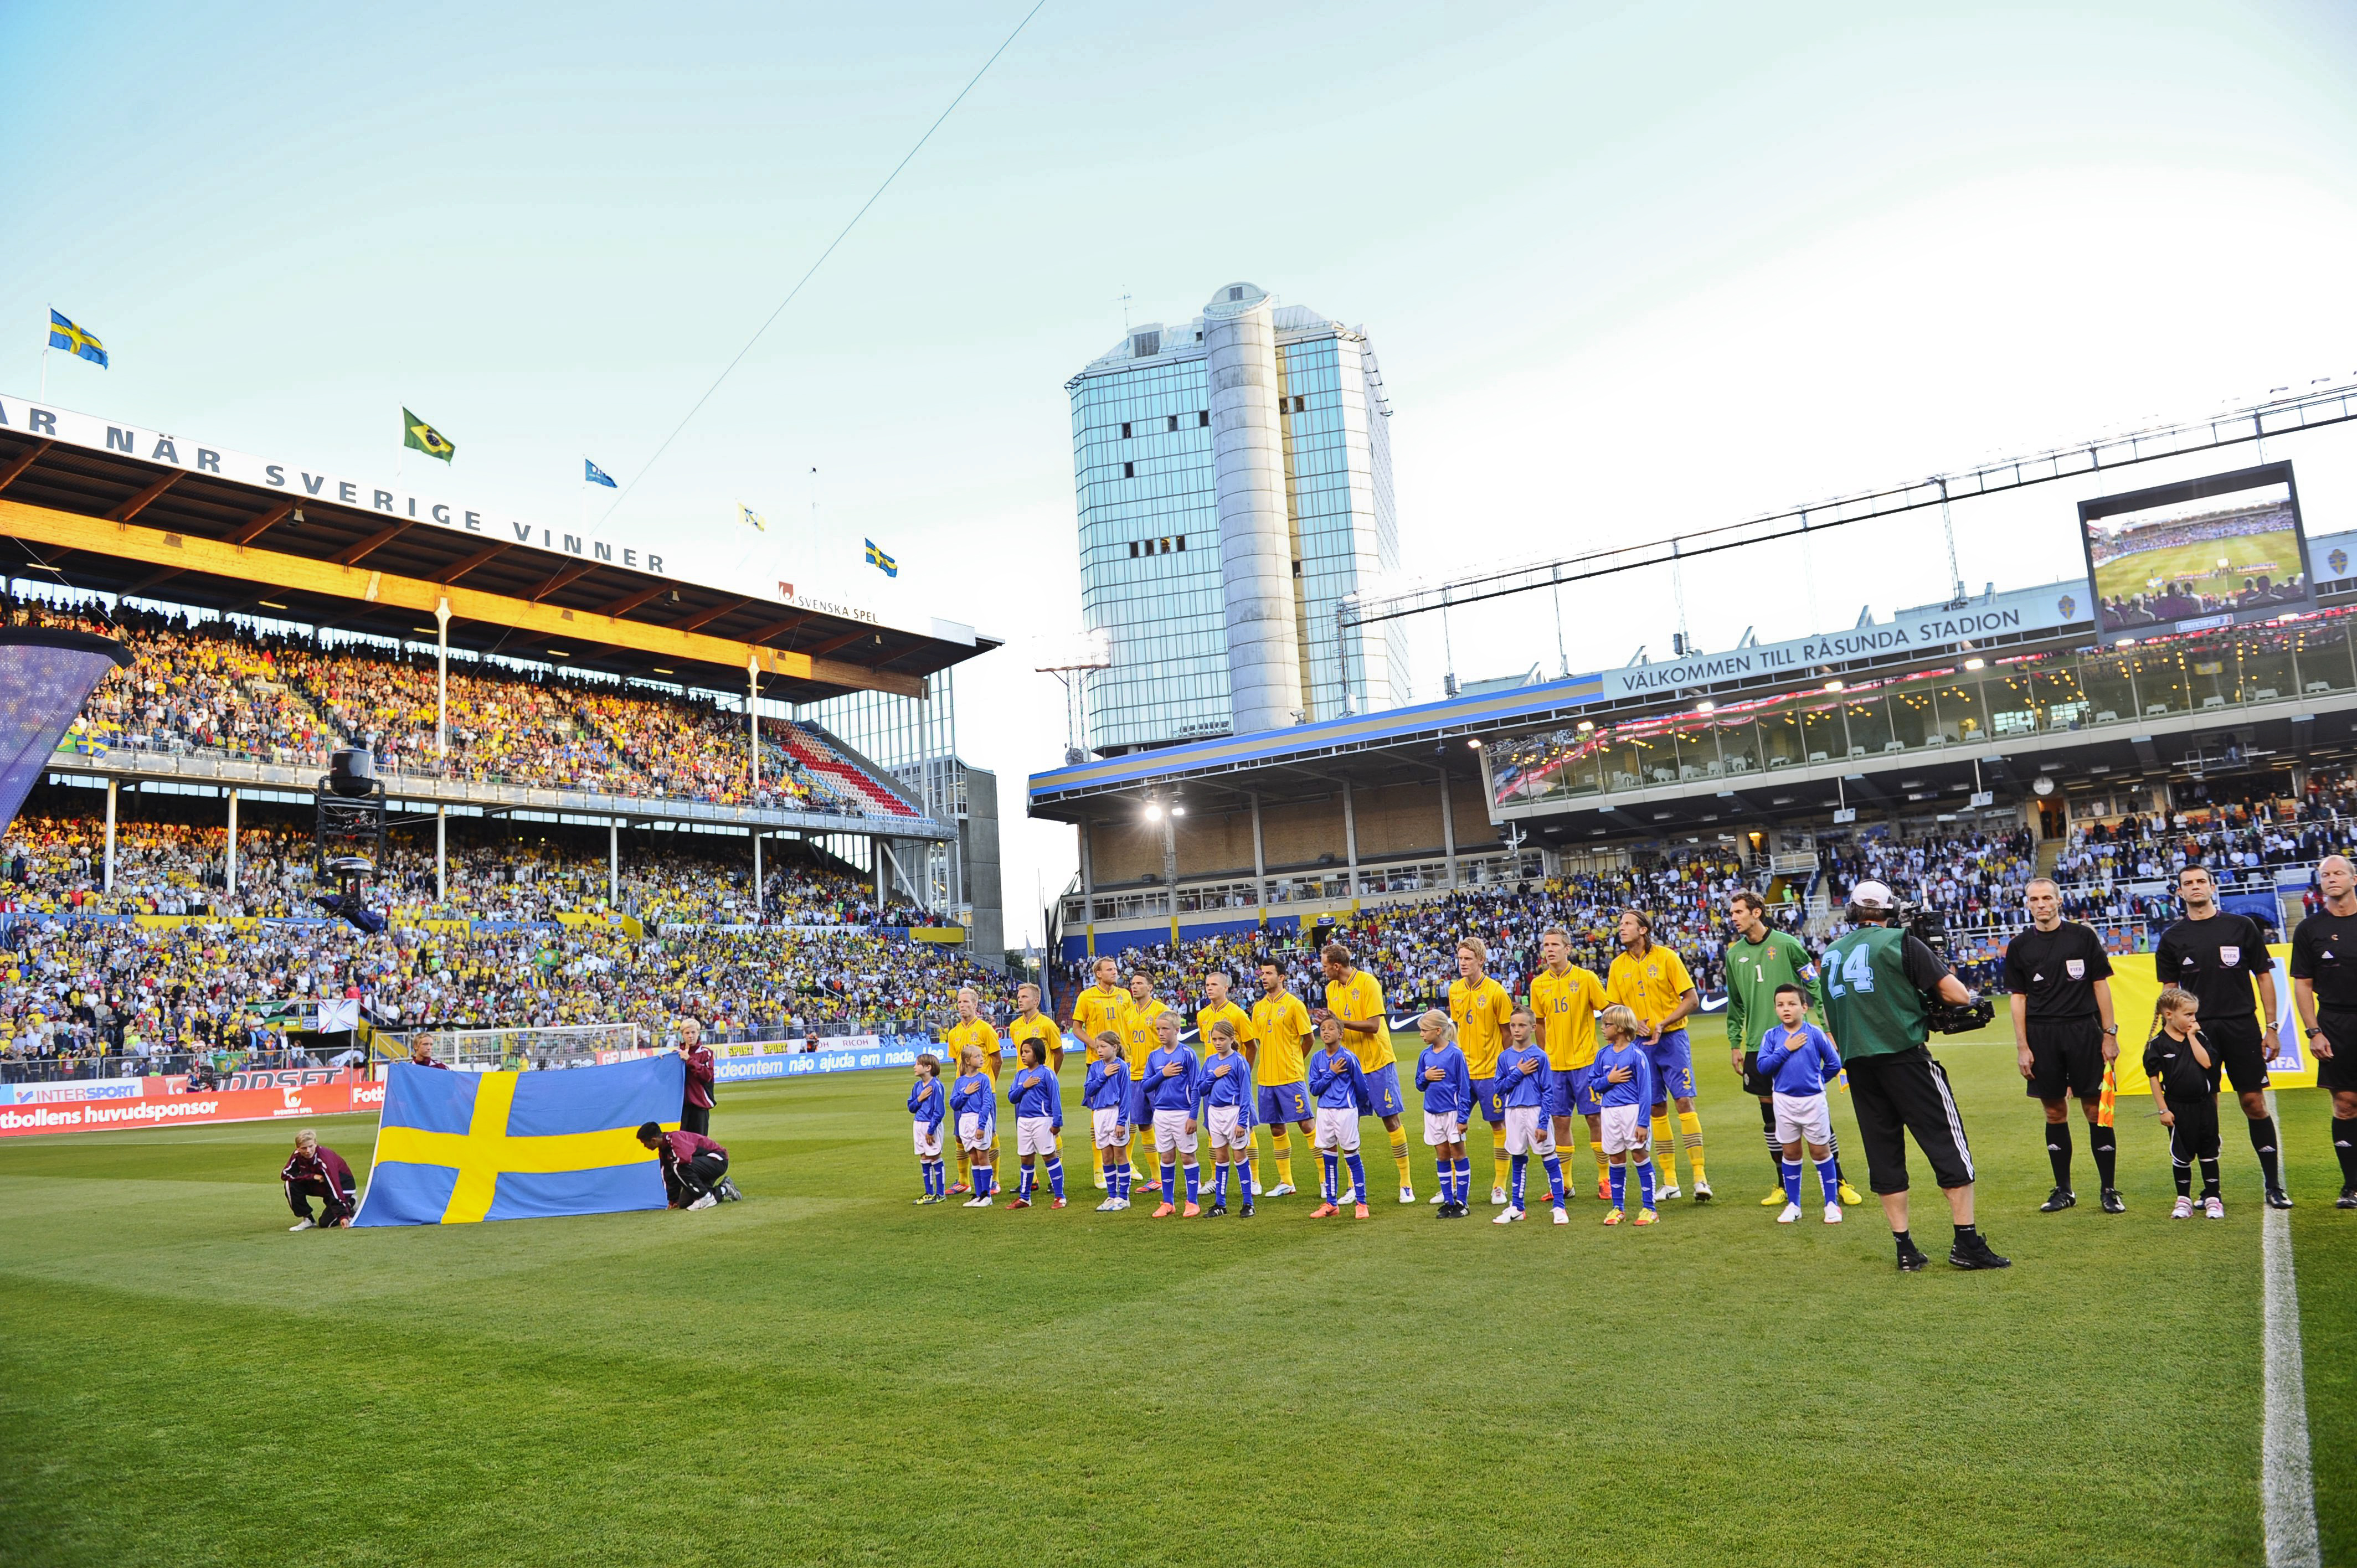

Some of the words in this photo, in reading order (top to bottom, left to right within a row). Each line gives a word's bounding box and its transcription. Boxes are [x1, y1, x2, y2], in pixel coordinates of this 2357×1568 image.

[106, 426, 220, 473] NÄR
[266, 465, 480, 532] SVERIGE
[513, 522, 663, 573] VINNER
[799, 596, 849, 616] SVENSKA
[853, 608, 878, 623] SPEL
[1622, 655, 1751, 691] VÄLKOMMEN
[1759, 648, 1795, 669] TILL
[1803, 628, 1910, 662] RÅSUNDA
[1920, 608, 2020, 641] STADION
[1756, 964, 1764, 983] 1
[1821, 943, 1874, 999] 24
[1344, 1004, 1352, 1019] 4
[1553, 997, 1569, 1013] 16
[1105, 1007, 1116, 1020] 11
[1466, 1009, 1473, 1024] 6
[1133, 1030, 1145, 1043] 20
[728, 1045, 754, 1056] SPORT
[763, 1043, 788, 1054] SPORT
[789, 1055, 815, 1072] não
[820, 1052, 855, 1073] ajuda
[860, 1053, 881, 1067] em
[216, 1067, 344, 1091] DDSET
[1682, 1068, 1691, 1085] 3
[37, 1085, 135, 1103] INTERSPORT
[1295, 1094, 1304, 1110] 5
[1384, 1088, 1392, 1103] 4
[1493, 1094, 1502, 1108] 6
[85, 1101, 219, 1123] huvudsponsor
